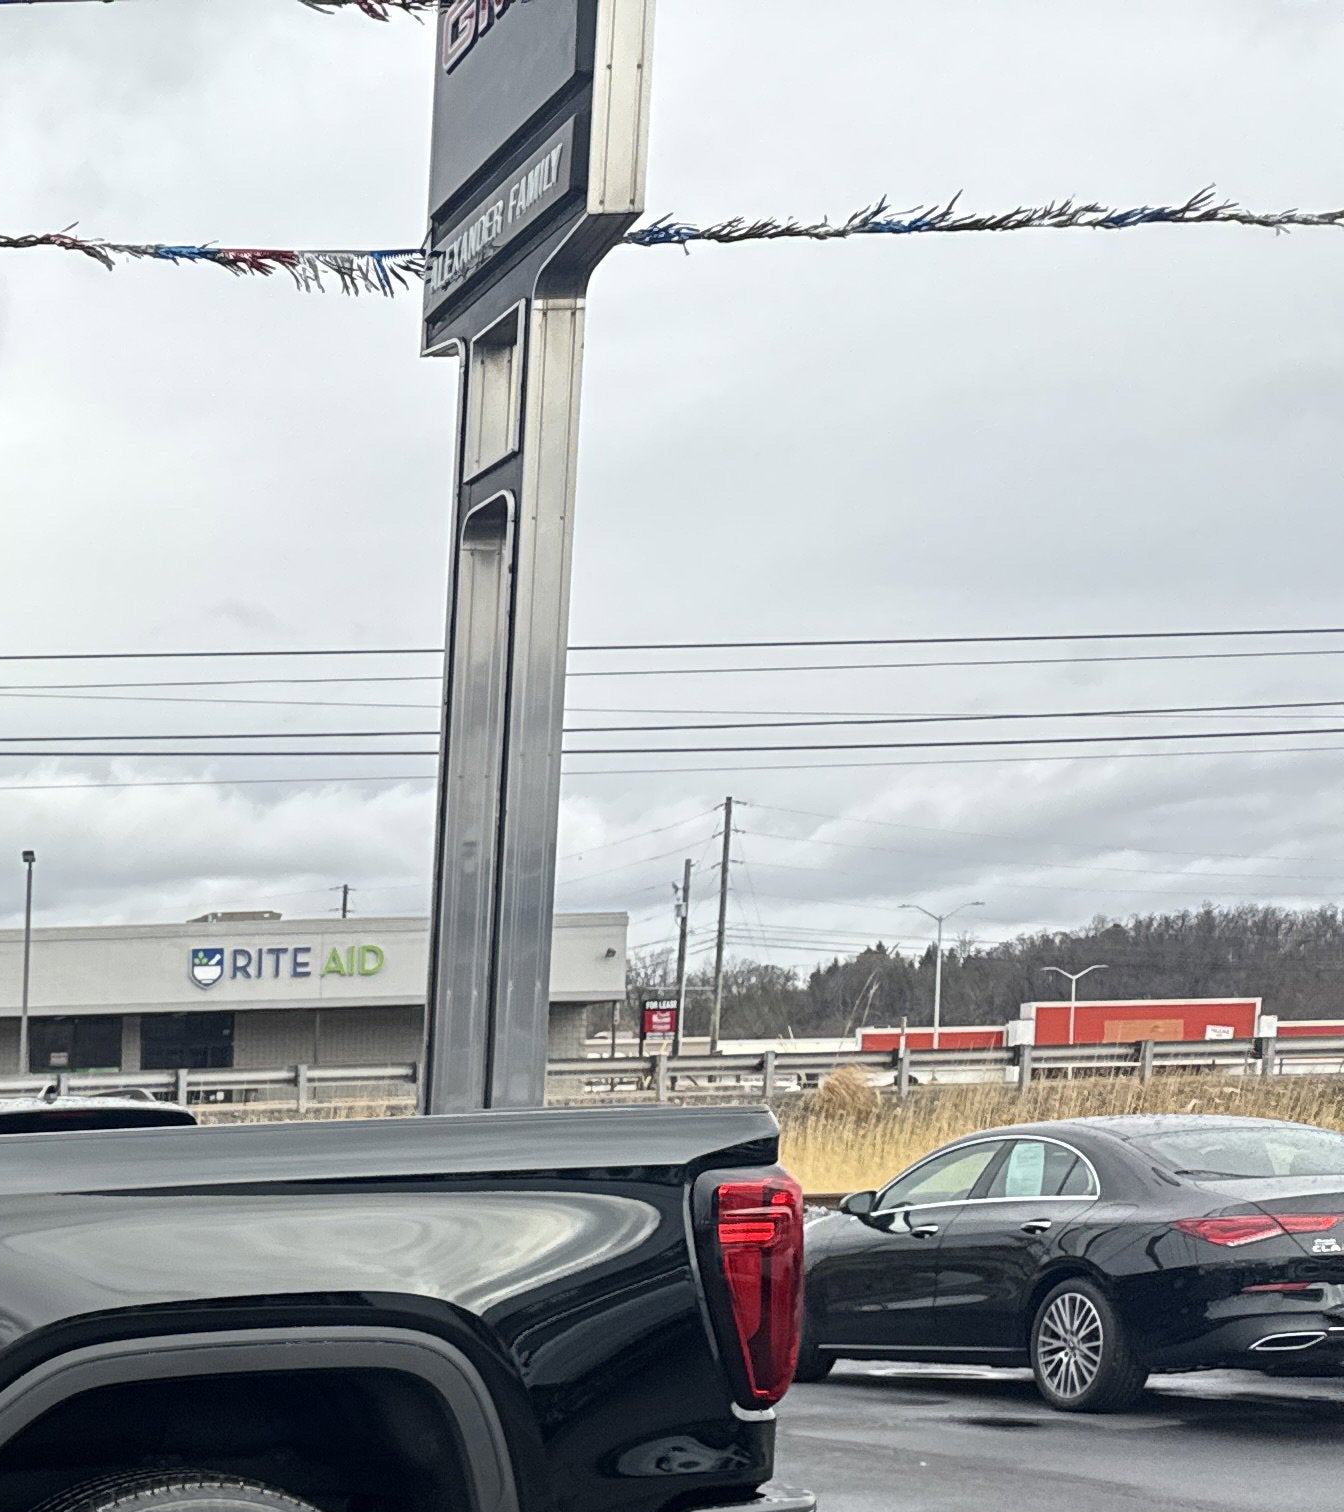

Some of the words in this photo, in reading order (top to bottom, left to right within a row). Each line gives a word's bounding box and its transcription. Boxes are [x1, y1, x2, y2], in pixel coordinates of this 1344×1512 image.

[430, 199, 504, 295] ALEXANDER
[508, 142, 563, 224] FAMILY
[229, 946, 312, 980] RITE
[320, 944, 385, 978] AID
[645, 1000, 658, 1010] FOR
